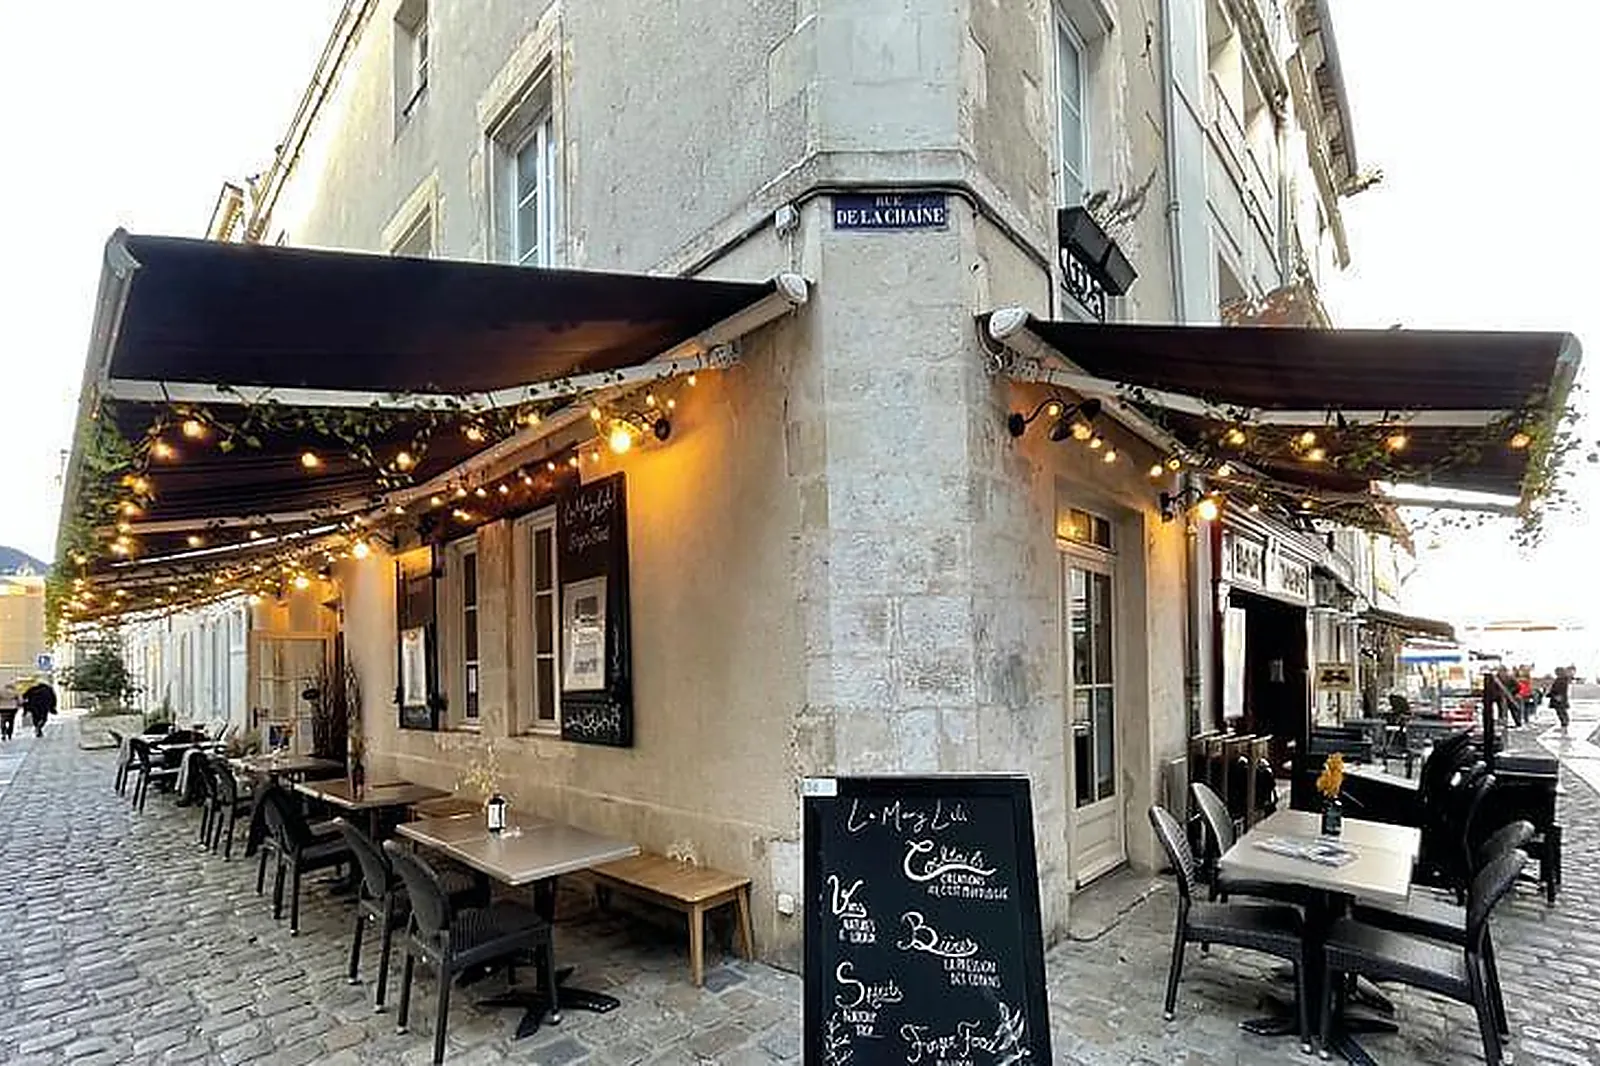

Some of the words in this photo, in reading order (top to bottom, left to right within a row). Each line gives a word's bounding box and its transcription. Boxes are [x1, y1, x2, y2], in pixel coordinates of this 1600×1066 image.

[876, 195, 902, 207] RUE
[836, 210, 858, 225] DE
[860, 209, 882, 225] LA
